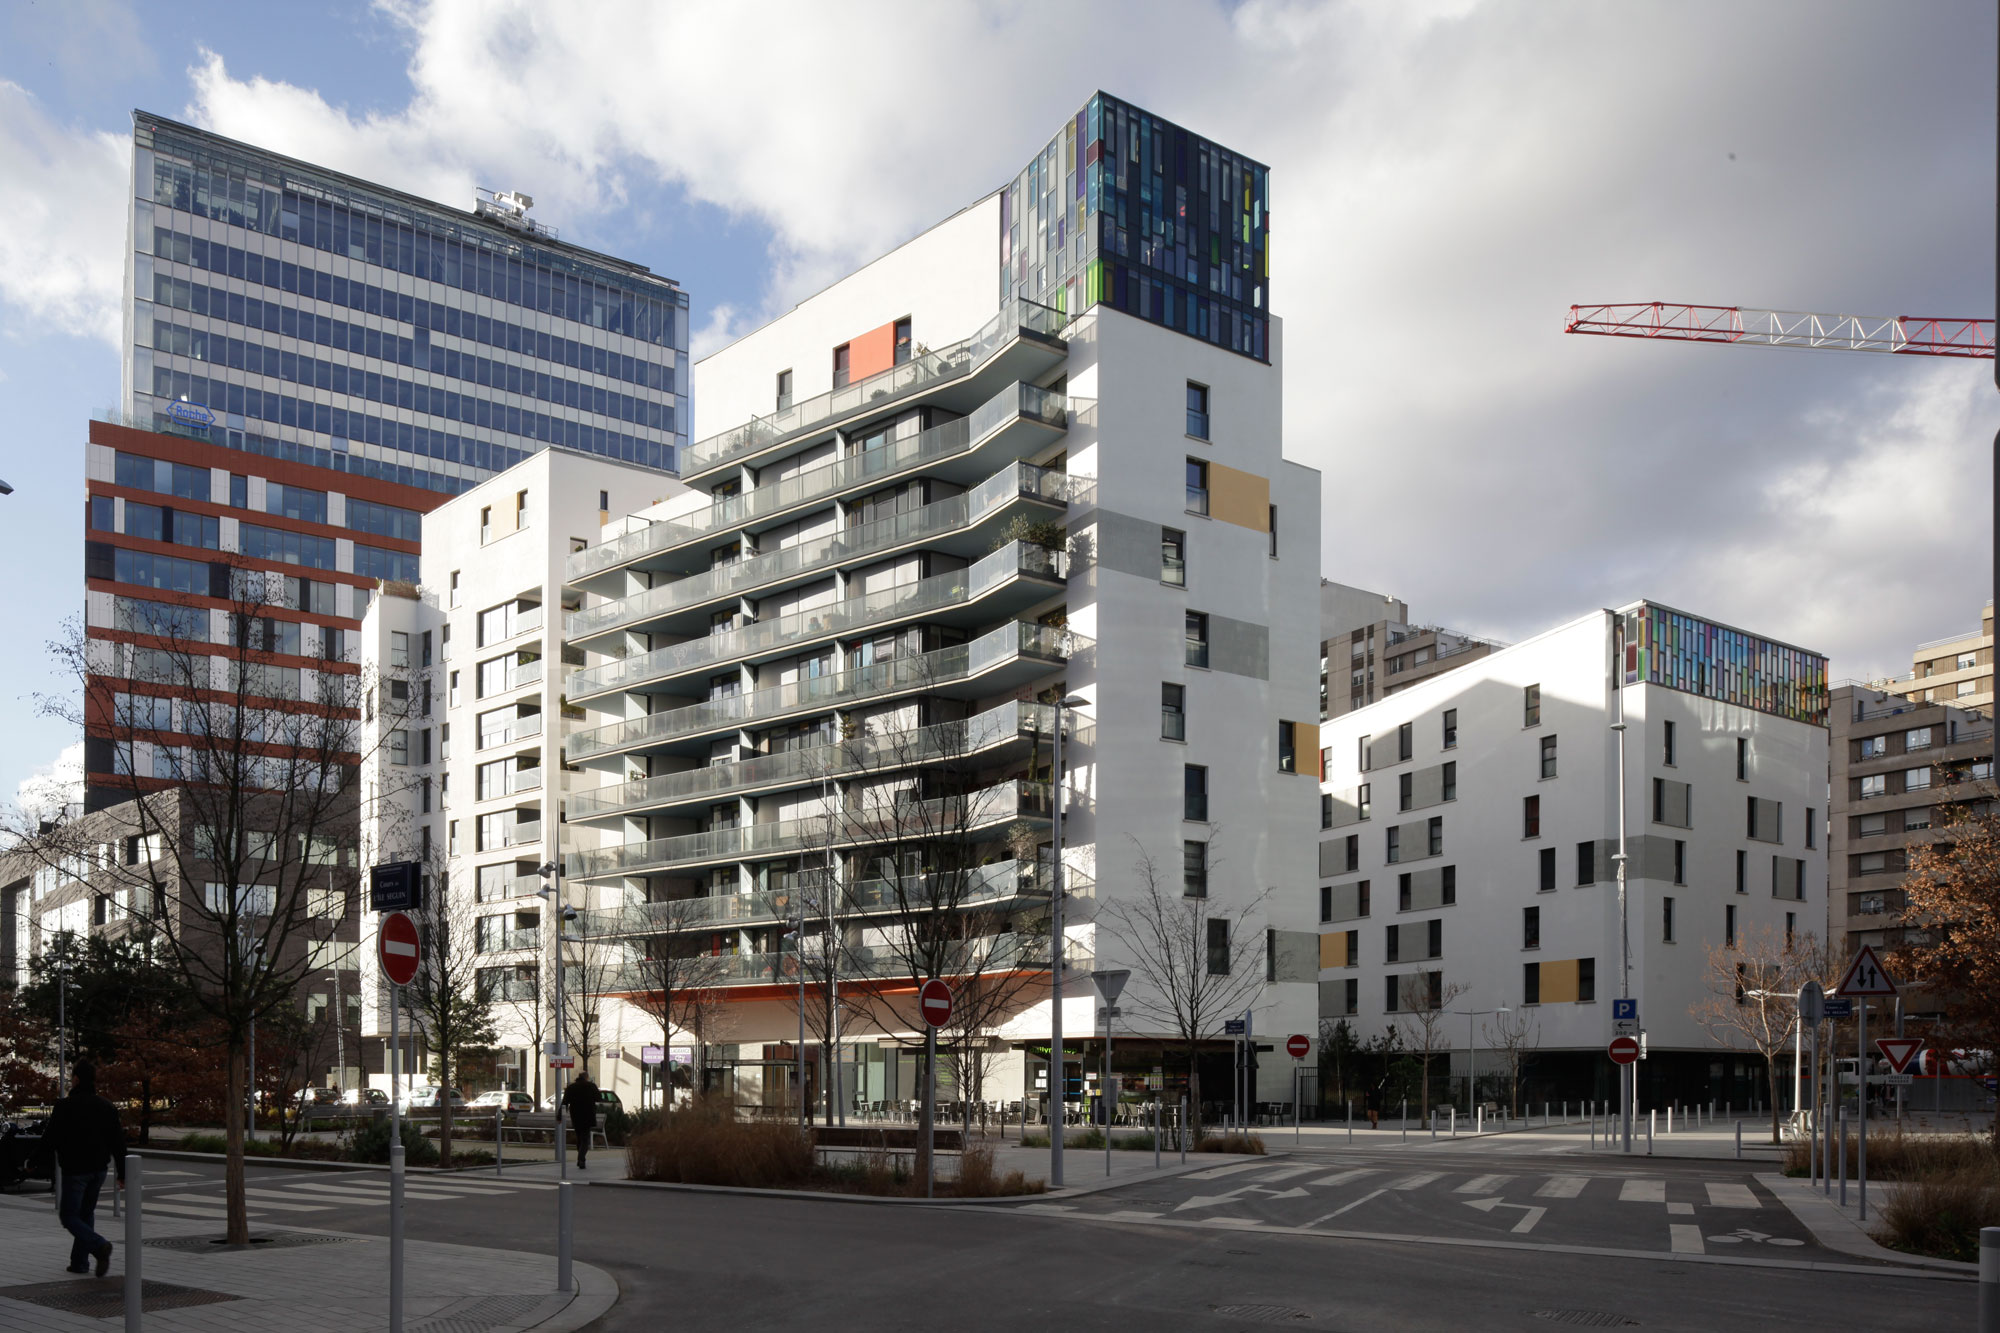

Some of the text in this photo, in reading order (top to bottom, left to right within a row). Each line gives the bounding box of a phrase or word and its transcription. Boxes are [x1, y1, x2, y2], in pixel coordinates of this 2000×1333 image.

[176, 405, 207, 421] Roche
[386, 891, 406, 900] SEGUIN
[1619, 1002, 1630, 1016] P
